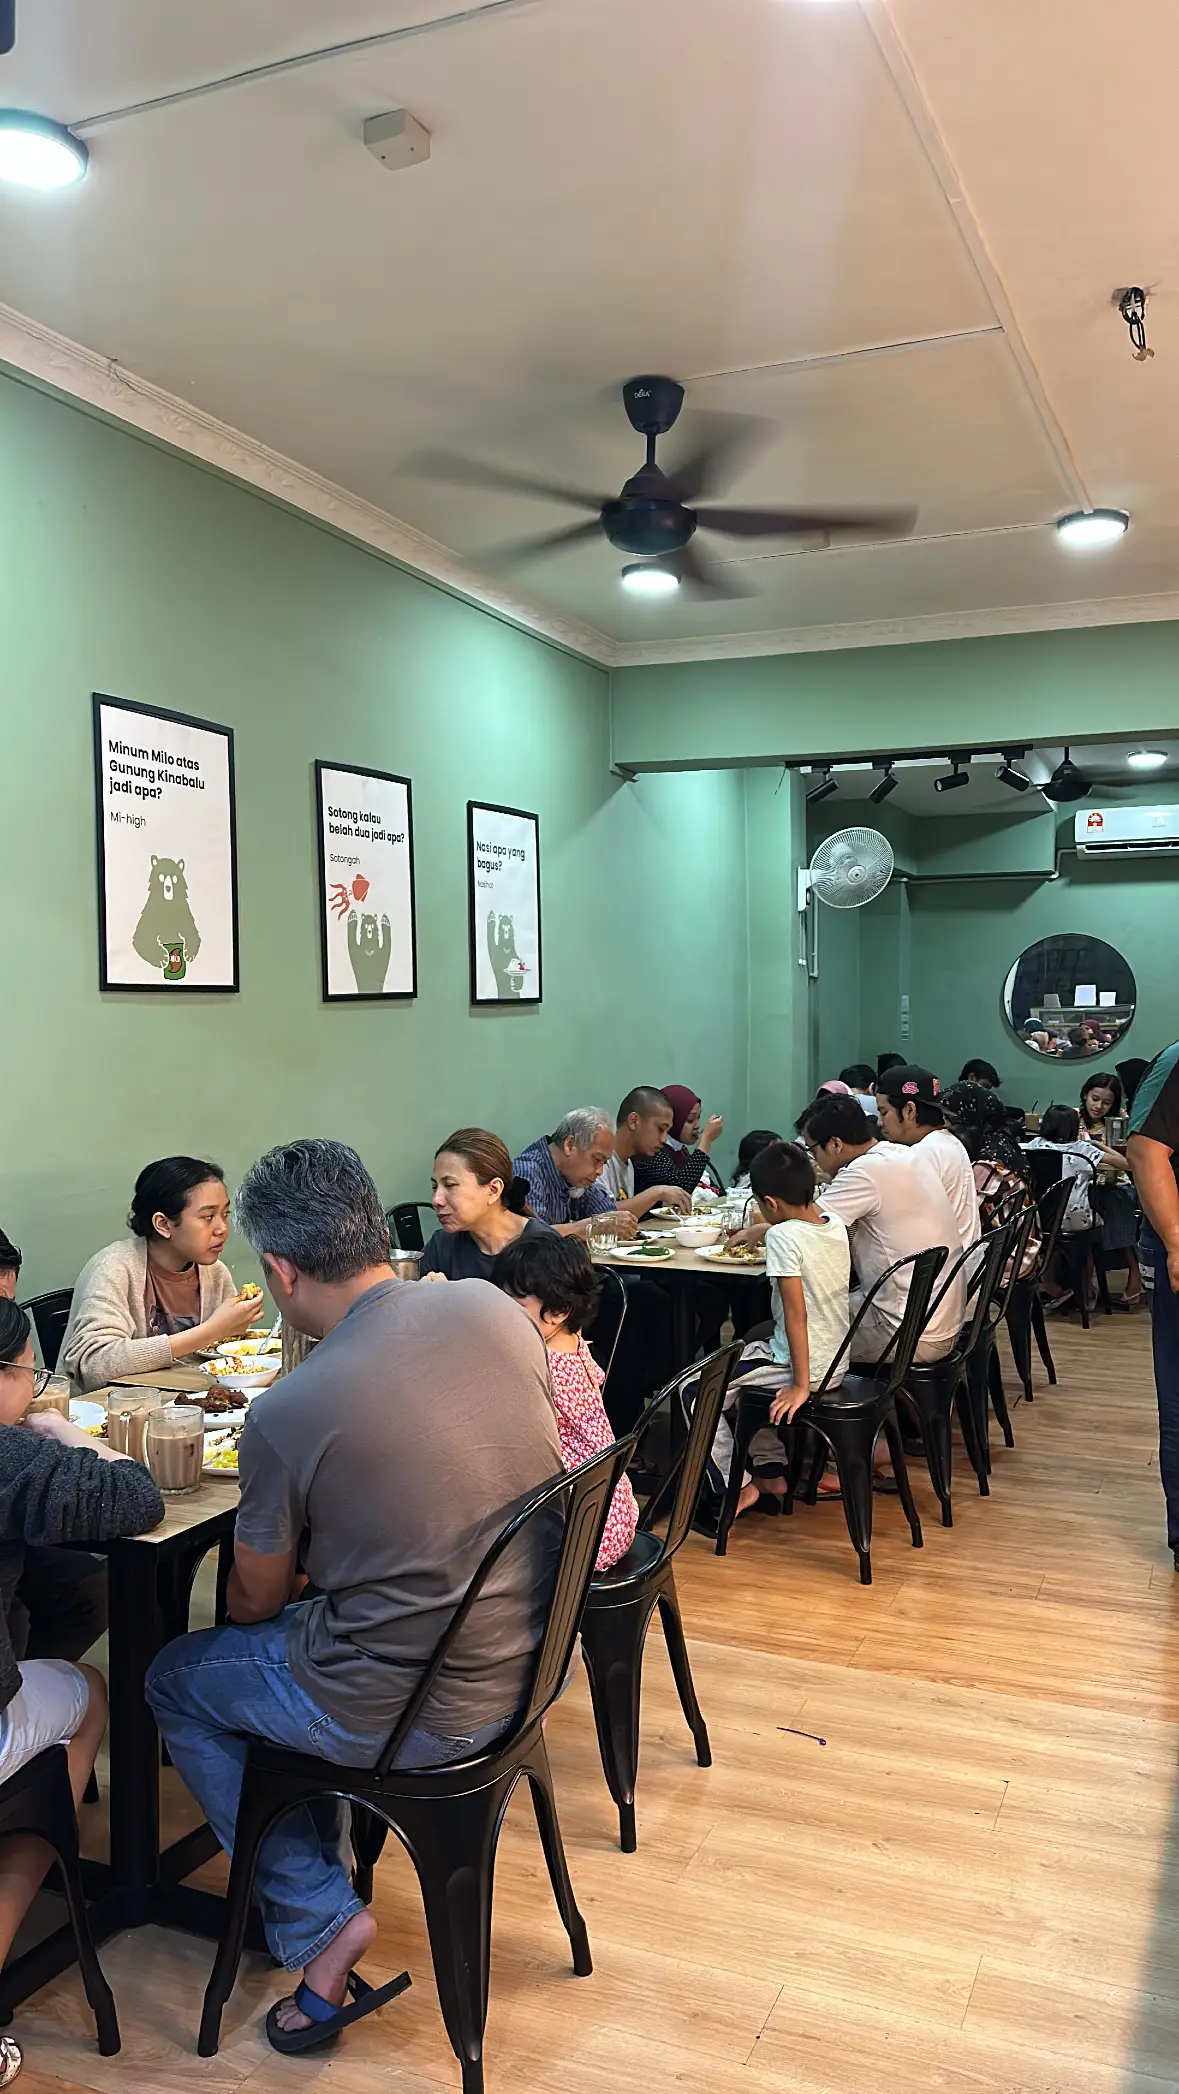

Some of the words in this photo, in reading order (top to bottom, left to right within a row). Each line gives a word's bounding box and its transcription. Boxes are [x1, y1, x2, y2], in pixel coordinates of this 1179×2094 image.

[109, 740, 149, 760] Minum
[152, 749, 174, 765] Milo
[176, 757, 199, 770] atas
[110, 760, 155, 783] Gunung
[158, 769, 205, 789] Kinabalu
[110, 777, 132, 794] jadi
[135, 786, 162, 800] apa?
[111, 812, 146, 828] Mi-high
[328, 806, 358, 824] Sotong
[360, 811, 381, 824] kalau
[329, 822, 353, 836] belah
[355, 826, 370, 838] dua
[371, 828, 386, 842] jadi
[387, 833, 405, 845] apa?
[330, 853, 361, 867] Sotongah
[477, 841, 491, 853] Nasi
[493, 845, 506, 858] apa
[508, 847, 525, 861] yang
[477, 857, 502, 873] bagus?
